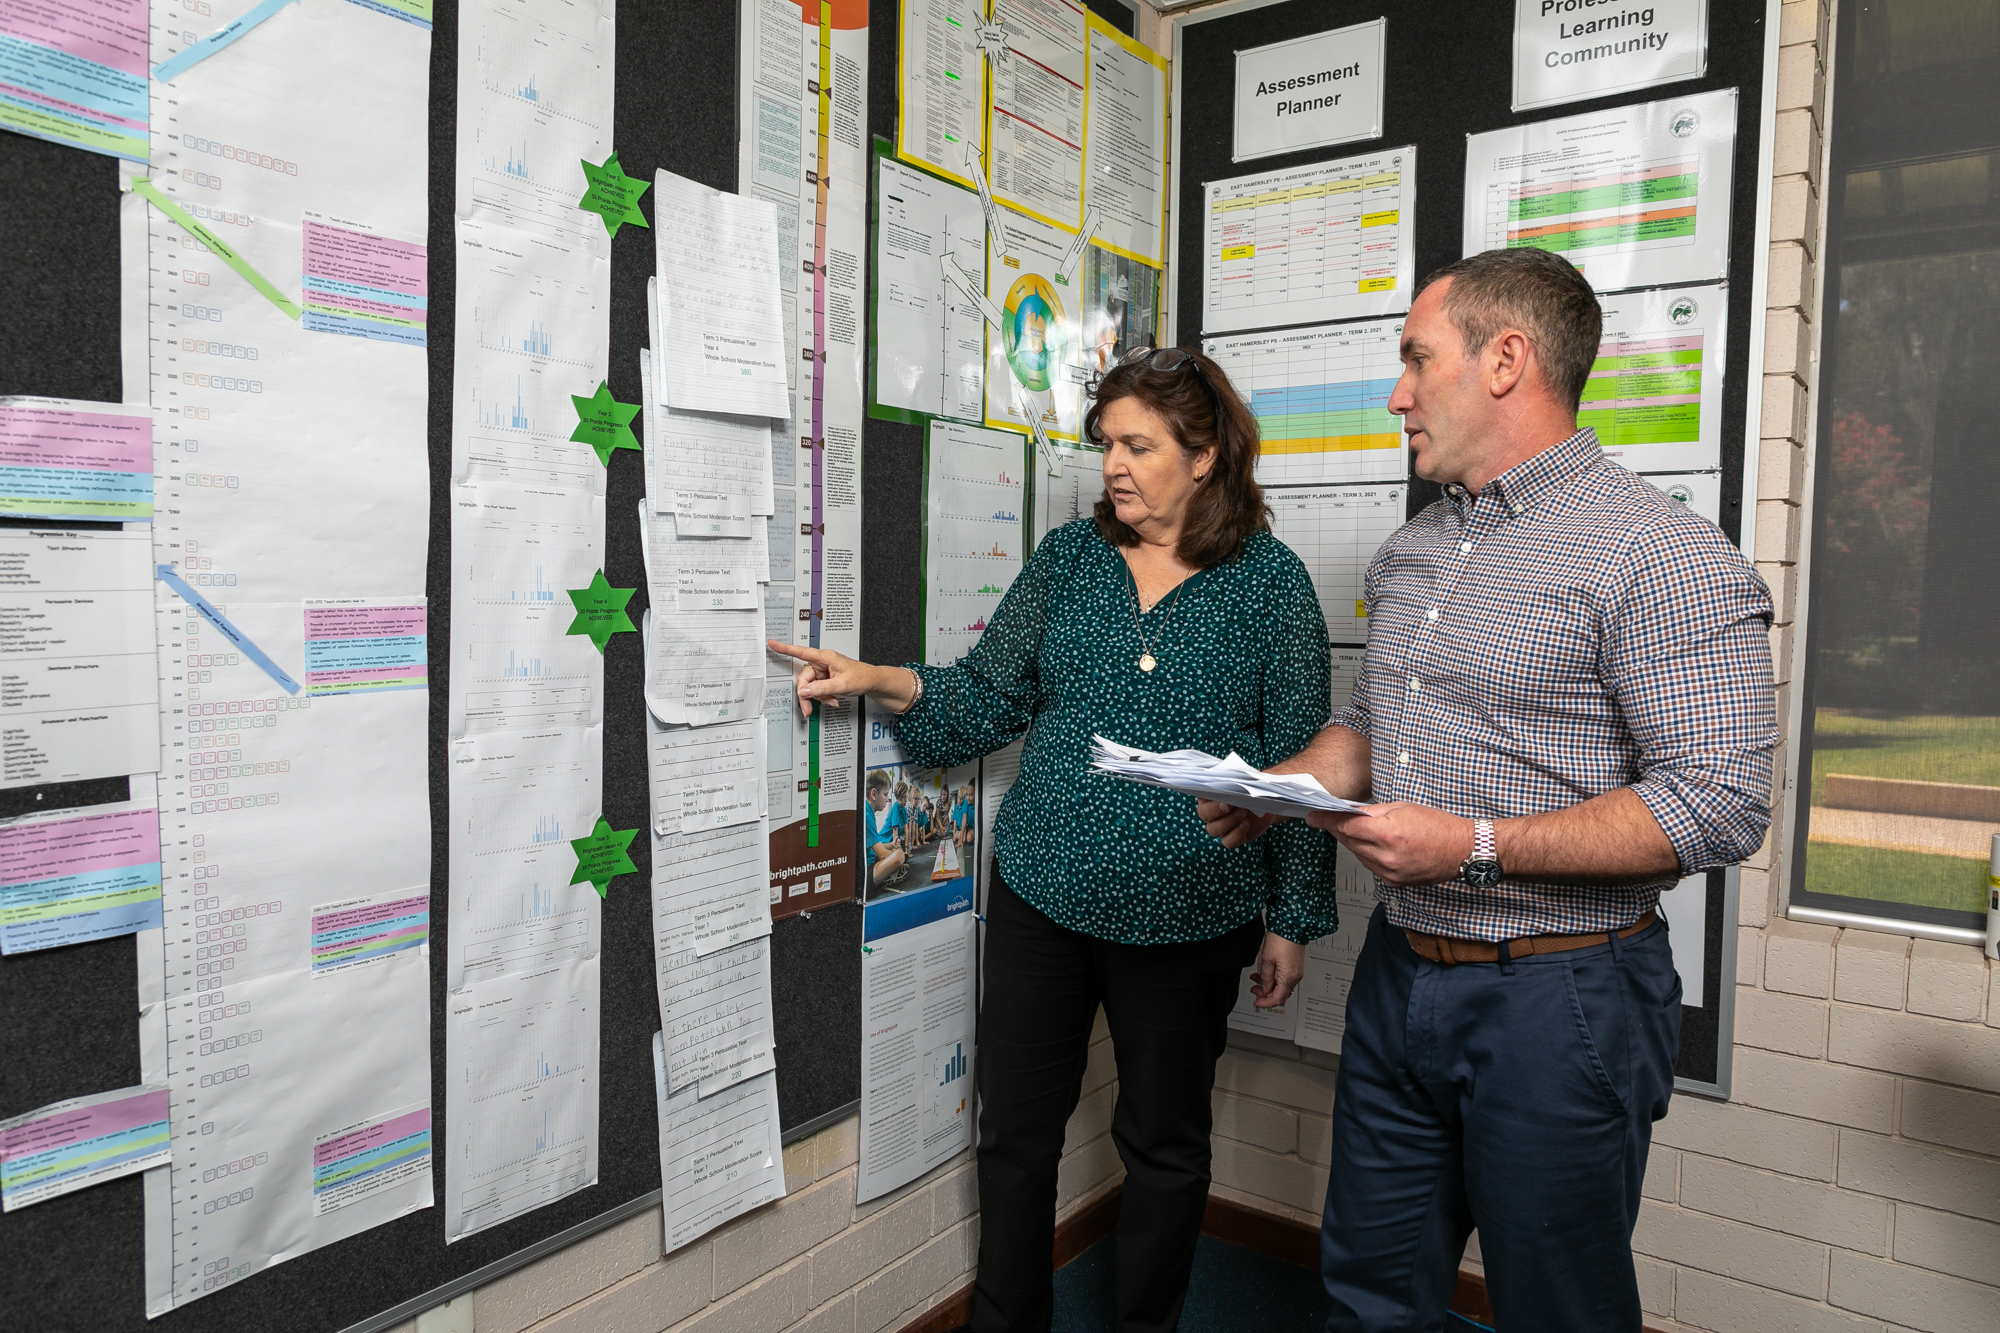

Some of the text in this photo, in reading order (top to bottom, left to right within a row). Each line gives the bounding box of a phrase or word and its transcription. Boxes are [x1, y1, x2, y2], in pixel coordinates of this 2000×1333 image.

[1560, 8, 1654, 39] Learning
[1545, 32, 1668, 68] Community
[1256, 62, 1359, 97] Assessment
[808, 82, 818, 92] 480
[1277, 94, 1341, 116] Planner
[807, 172, 816, 182] 440
[1244, 178, 1272, 188] HAMERSLEY
[1285, 171, 1317, 181] ASSESSMENT
[1318, 167, 1342, 176] PLANNER
[601, 187, 624, 199] ACHIEVED
[598, 195, 611, 204] Points
[612, 200, 630, 211] Progress
[600, 204, 624, 216] ACHIEVED
[720, 337, 745, 345] Persuasive
[737, 358, 762, 366] Moderation
[700, 786, 723, 795] Persuasive
[714, 804, 738, 812] Moderation
[591, 850, 614, 859] ACHIEVED
[590, 866, 614, 875] ACHIEVED
[770, 856, 848, 881] brightpath.com.au
[947, 899, 969, 911] brightpath
[711, 906, 735, 918] Persuasive
[710, 927, 726, 937] School
[727, 921, 749, 932] Moderation
[729, 933, 739, 942] 240
[881, 1023, 898, 1033] Brightpath
